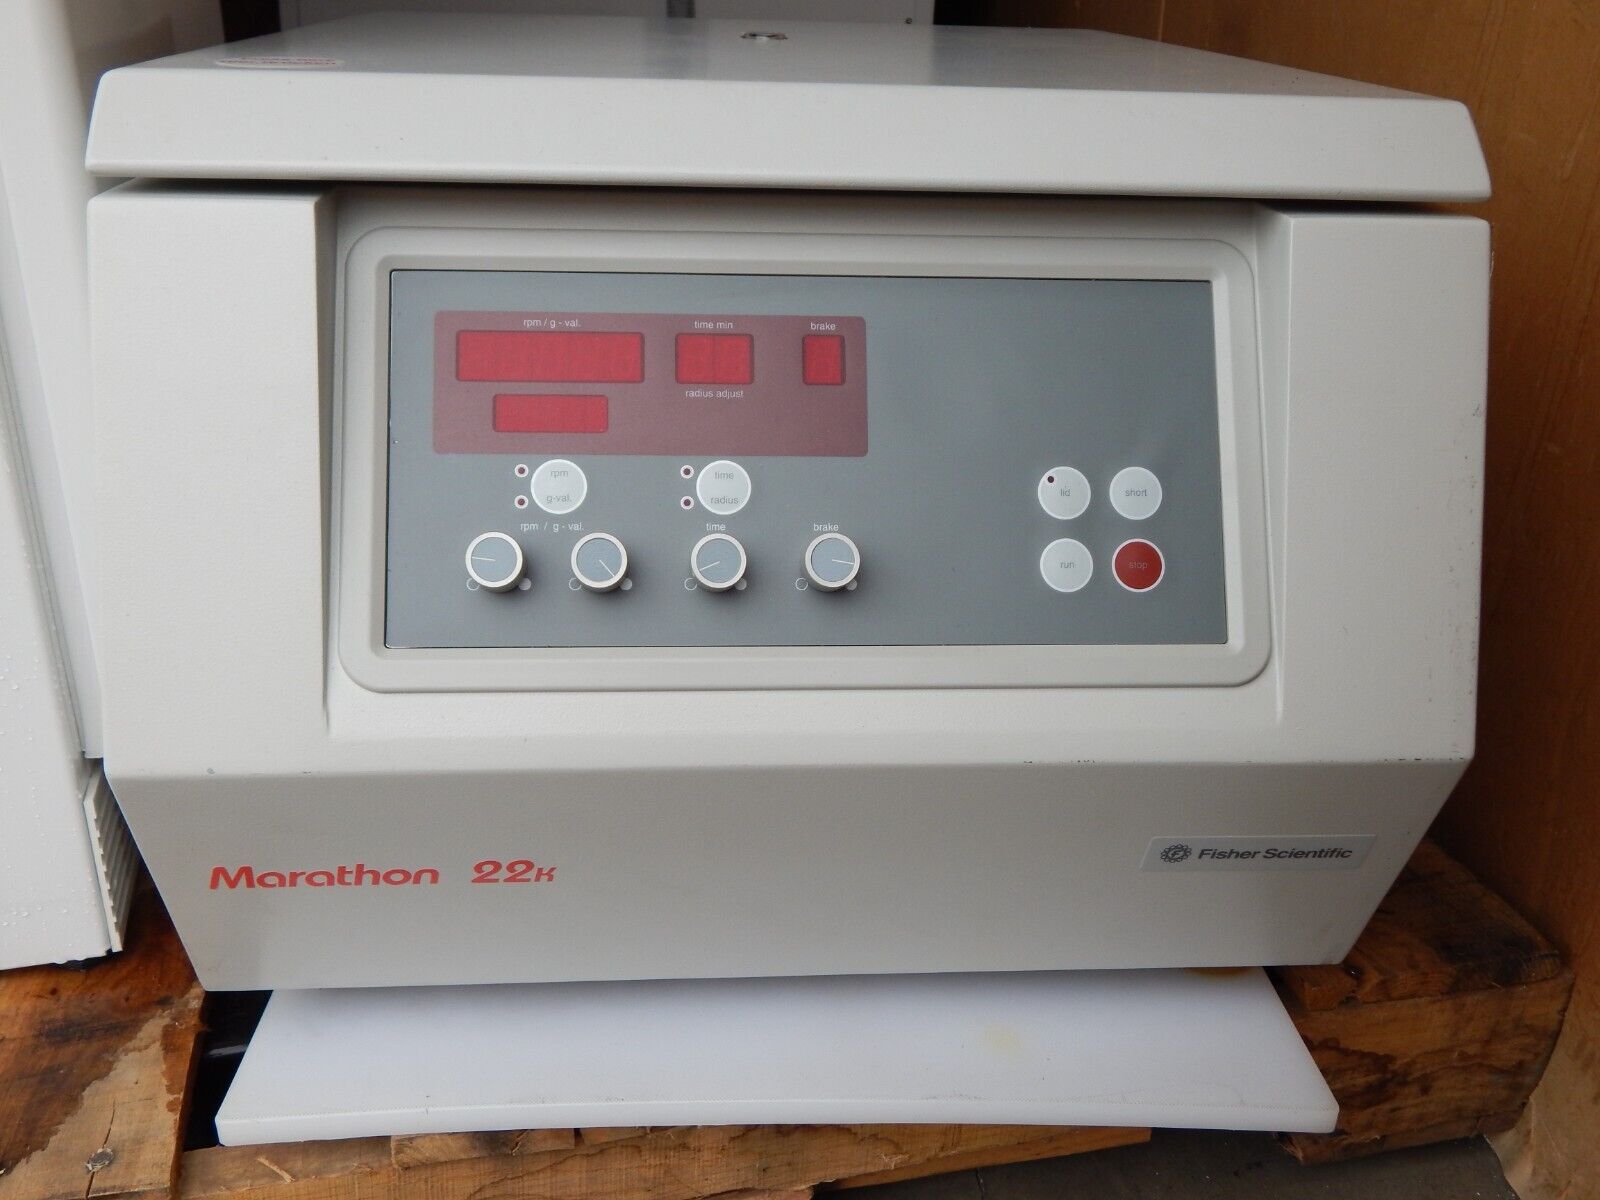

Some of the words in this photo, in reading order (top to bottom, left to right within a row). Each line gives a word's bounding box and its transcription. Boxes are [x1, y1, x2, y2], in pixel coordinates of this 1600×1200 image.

[523, 319, 542, 328] rpm
[694, 320, 714, 330] time
[716, 321, 734, 330] min
[810, 322, 837, 330] brake
[685, 389, 714, 398] radius
[716, 389, 744, 400] adjust
[550, 470, 569, 478] rpm
[714, 471, 734, 480] time
[1060, 488, 1071, 497] lid
[1125, 488, 1147, 497] short
[710, 494, 739, 505] radius
[520, 522, 539, 532] rpm
[706, 522, 726, 532] time
[813, 523, 839, 531] brake
[1060, 561, 1075, 569] run
[1128, 560, 1148, 570] stop
[1198, 848, 1260, 860] Fisher
[1262, 847, 1353, 860] Scientific
[209, 863, 440, 890] Marathon
